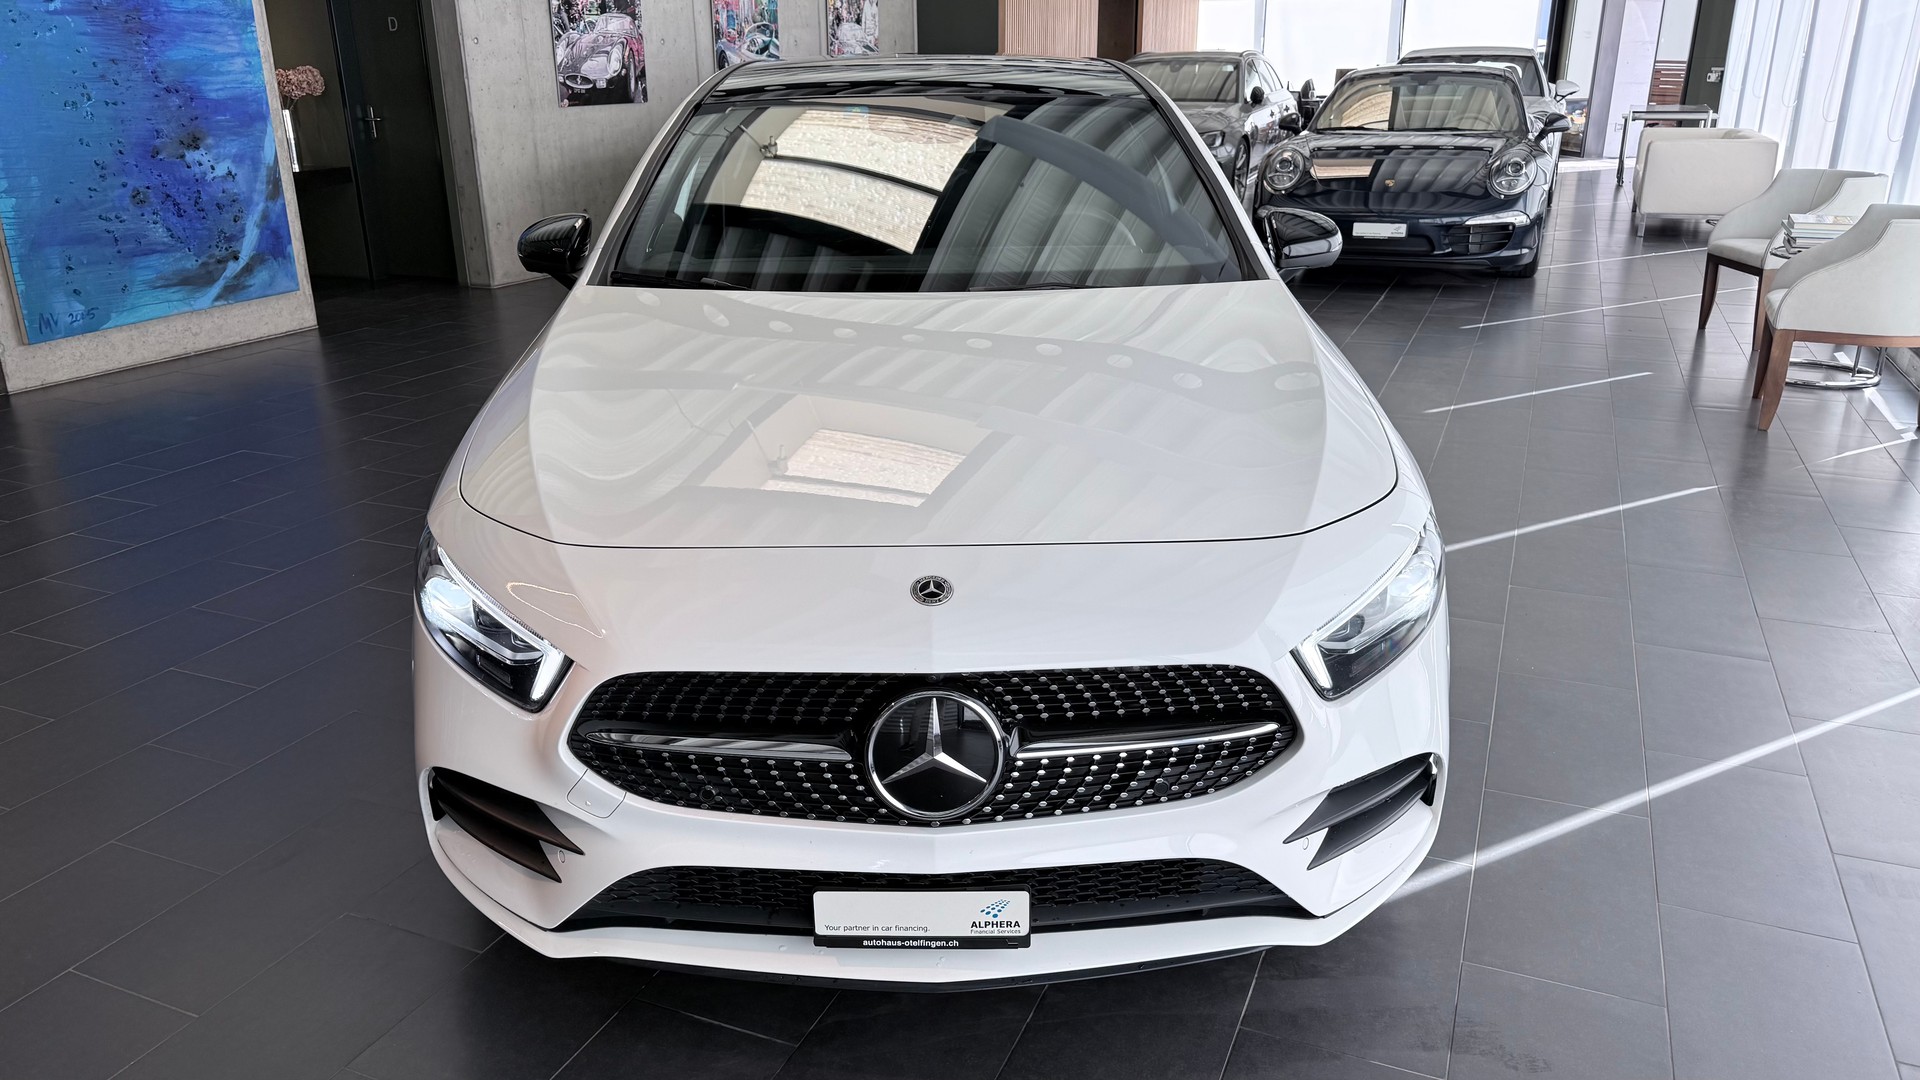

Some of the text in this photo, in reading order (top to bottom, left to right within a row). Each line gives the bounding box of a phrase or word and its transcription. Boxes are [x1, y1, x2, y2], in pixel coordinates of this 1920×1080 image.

[387, 16, 398, 31] D
[843, 924, 870, 932] partner
[894, 924, 931, 933] financing.
[970, 920, 1021, 929] ALPHERA
[862, 938, 959, 949] autohaus-otelfingen.ch
